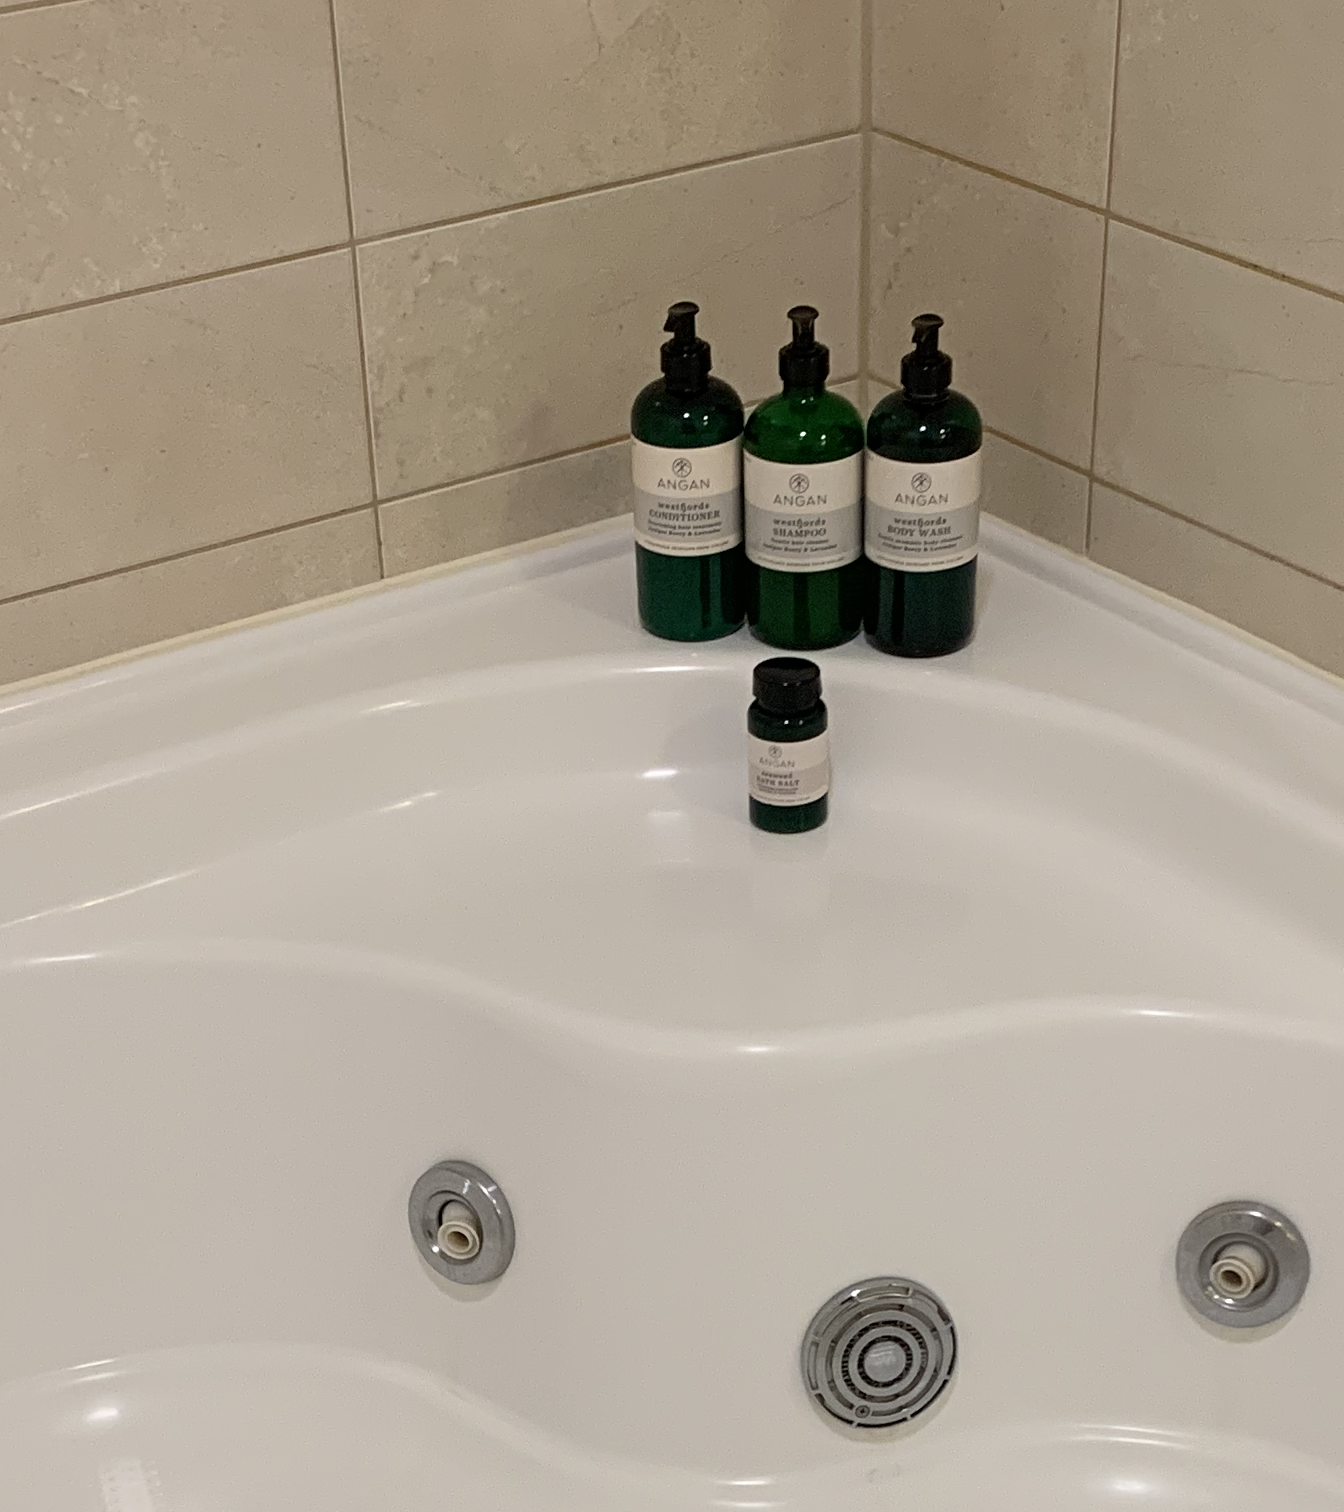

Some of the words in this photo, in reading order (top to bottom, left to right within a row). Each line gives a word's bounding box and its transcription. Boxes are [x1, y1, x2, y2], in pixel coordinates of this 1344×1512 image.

[657, 478, 711, 491] ANGAN
[772, 494, 828, 507] ANGAN
[894, 493, 949, 507] ANGAN
[657, 502, 710, 513] westfjords
[649, 509, 721, 522] CONDITIONER
[893, 516, 948, 528] westfjords
[772, 517, 827, 529] westfjords
[772, 527, 827, 538] SHAMPOO
[887, 524, 916, 538] BODY
[918, 525, 952, 538] WASH
